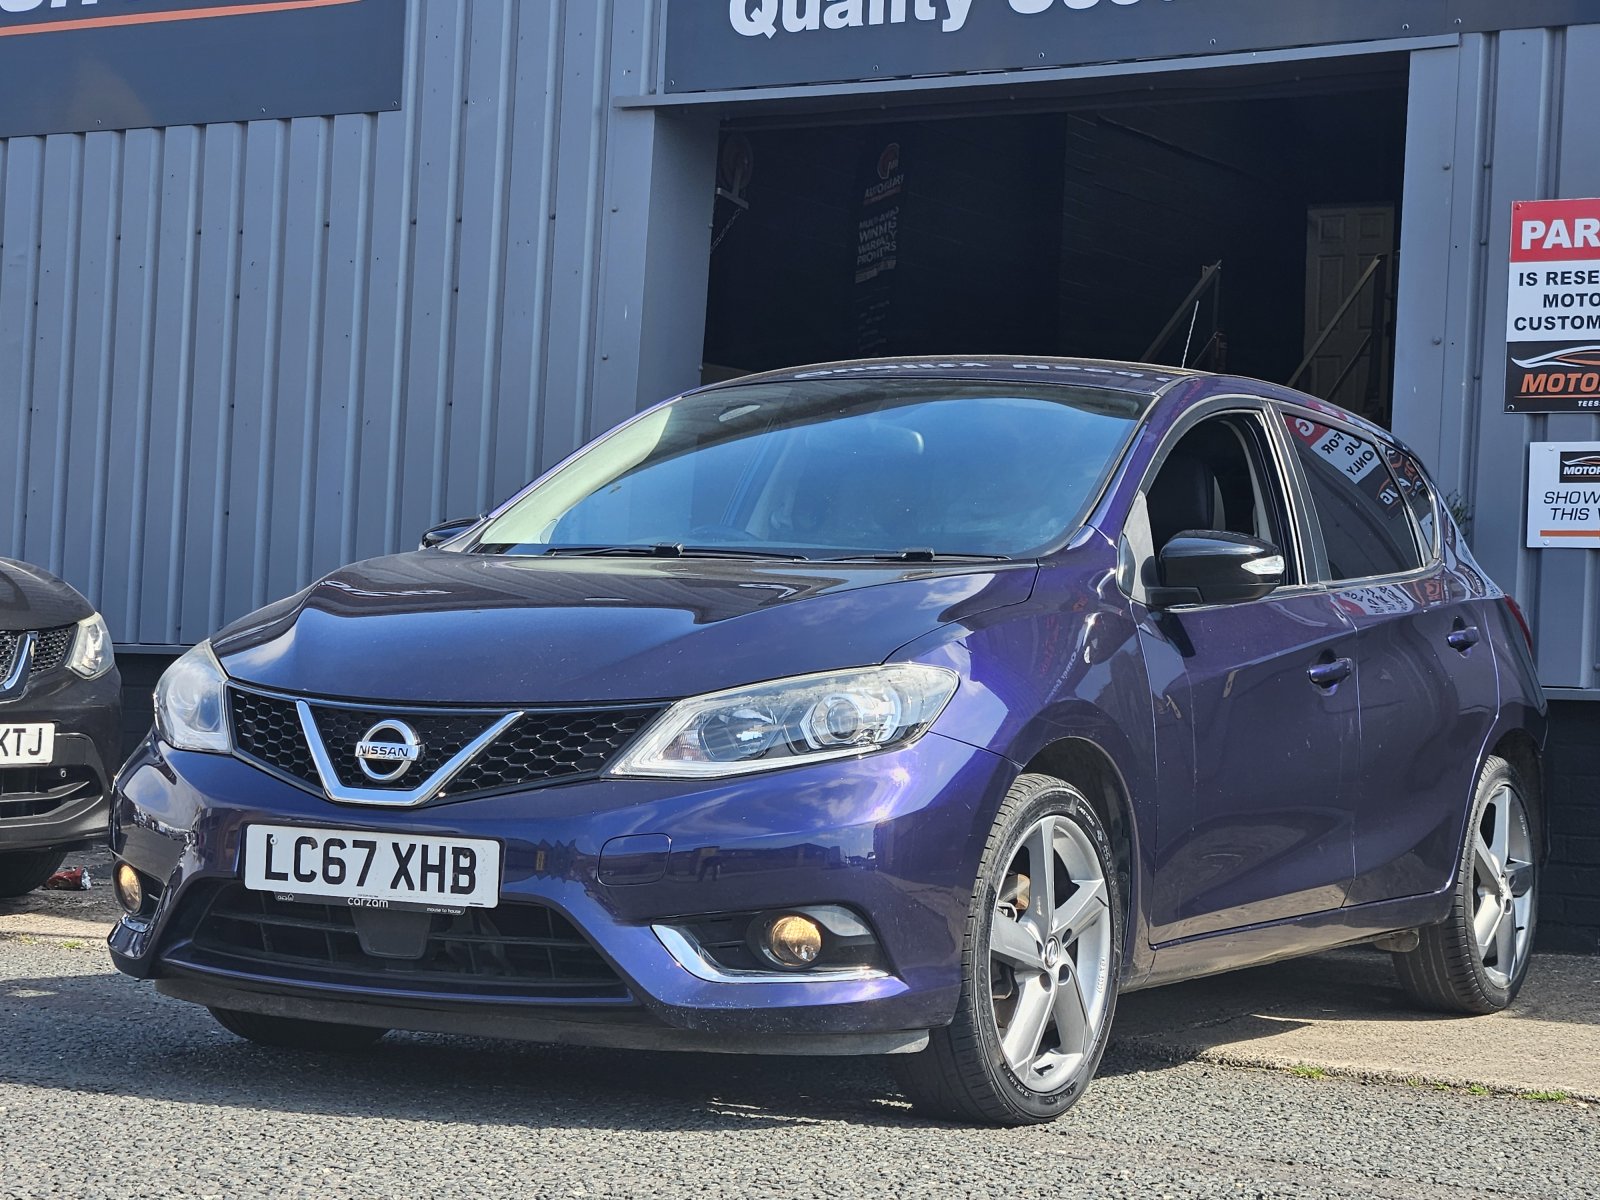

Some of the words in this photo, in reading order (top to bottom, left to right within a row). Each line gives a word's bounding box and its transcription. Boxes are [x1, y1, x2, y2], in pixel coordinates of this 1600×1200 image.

[1521, 218, 1600, 250] PAR
[1519, 272, 1538, 287] IS
[1546, 270, 1600, 286] RESE
[1520, 373, 1600, 393] MOTO
[1577, 400, 1600, 408] TEES
[1550, 508, 1590, 521] THIS
[358, 745, 409, 757] NISSAN
[264, 833, 377, 887] LC67
[389, 842, 477, 895] XHB
[347, 897, 389, 909] carzam
